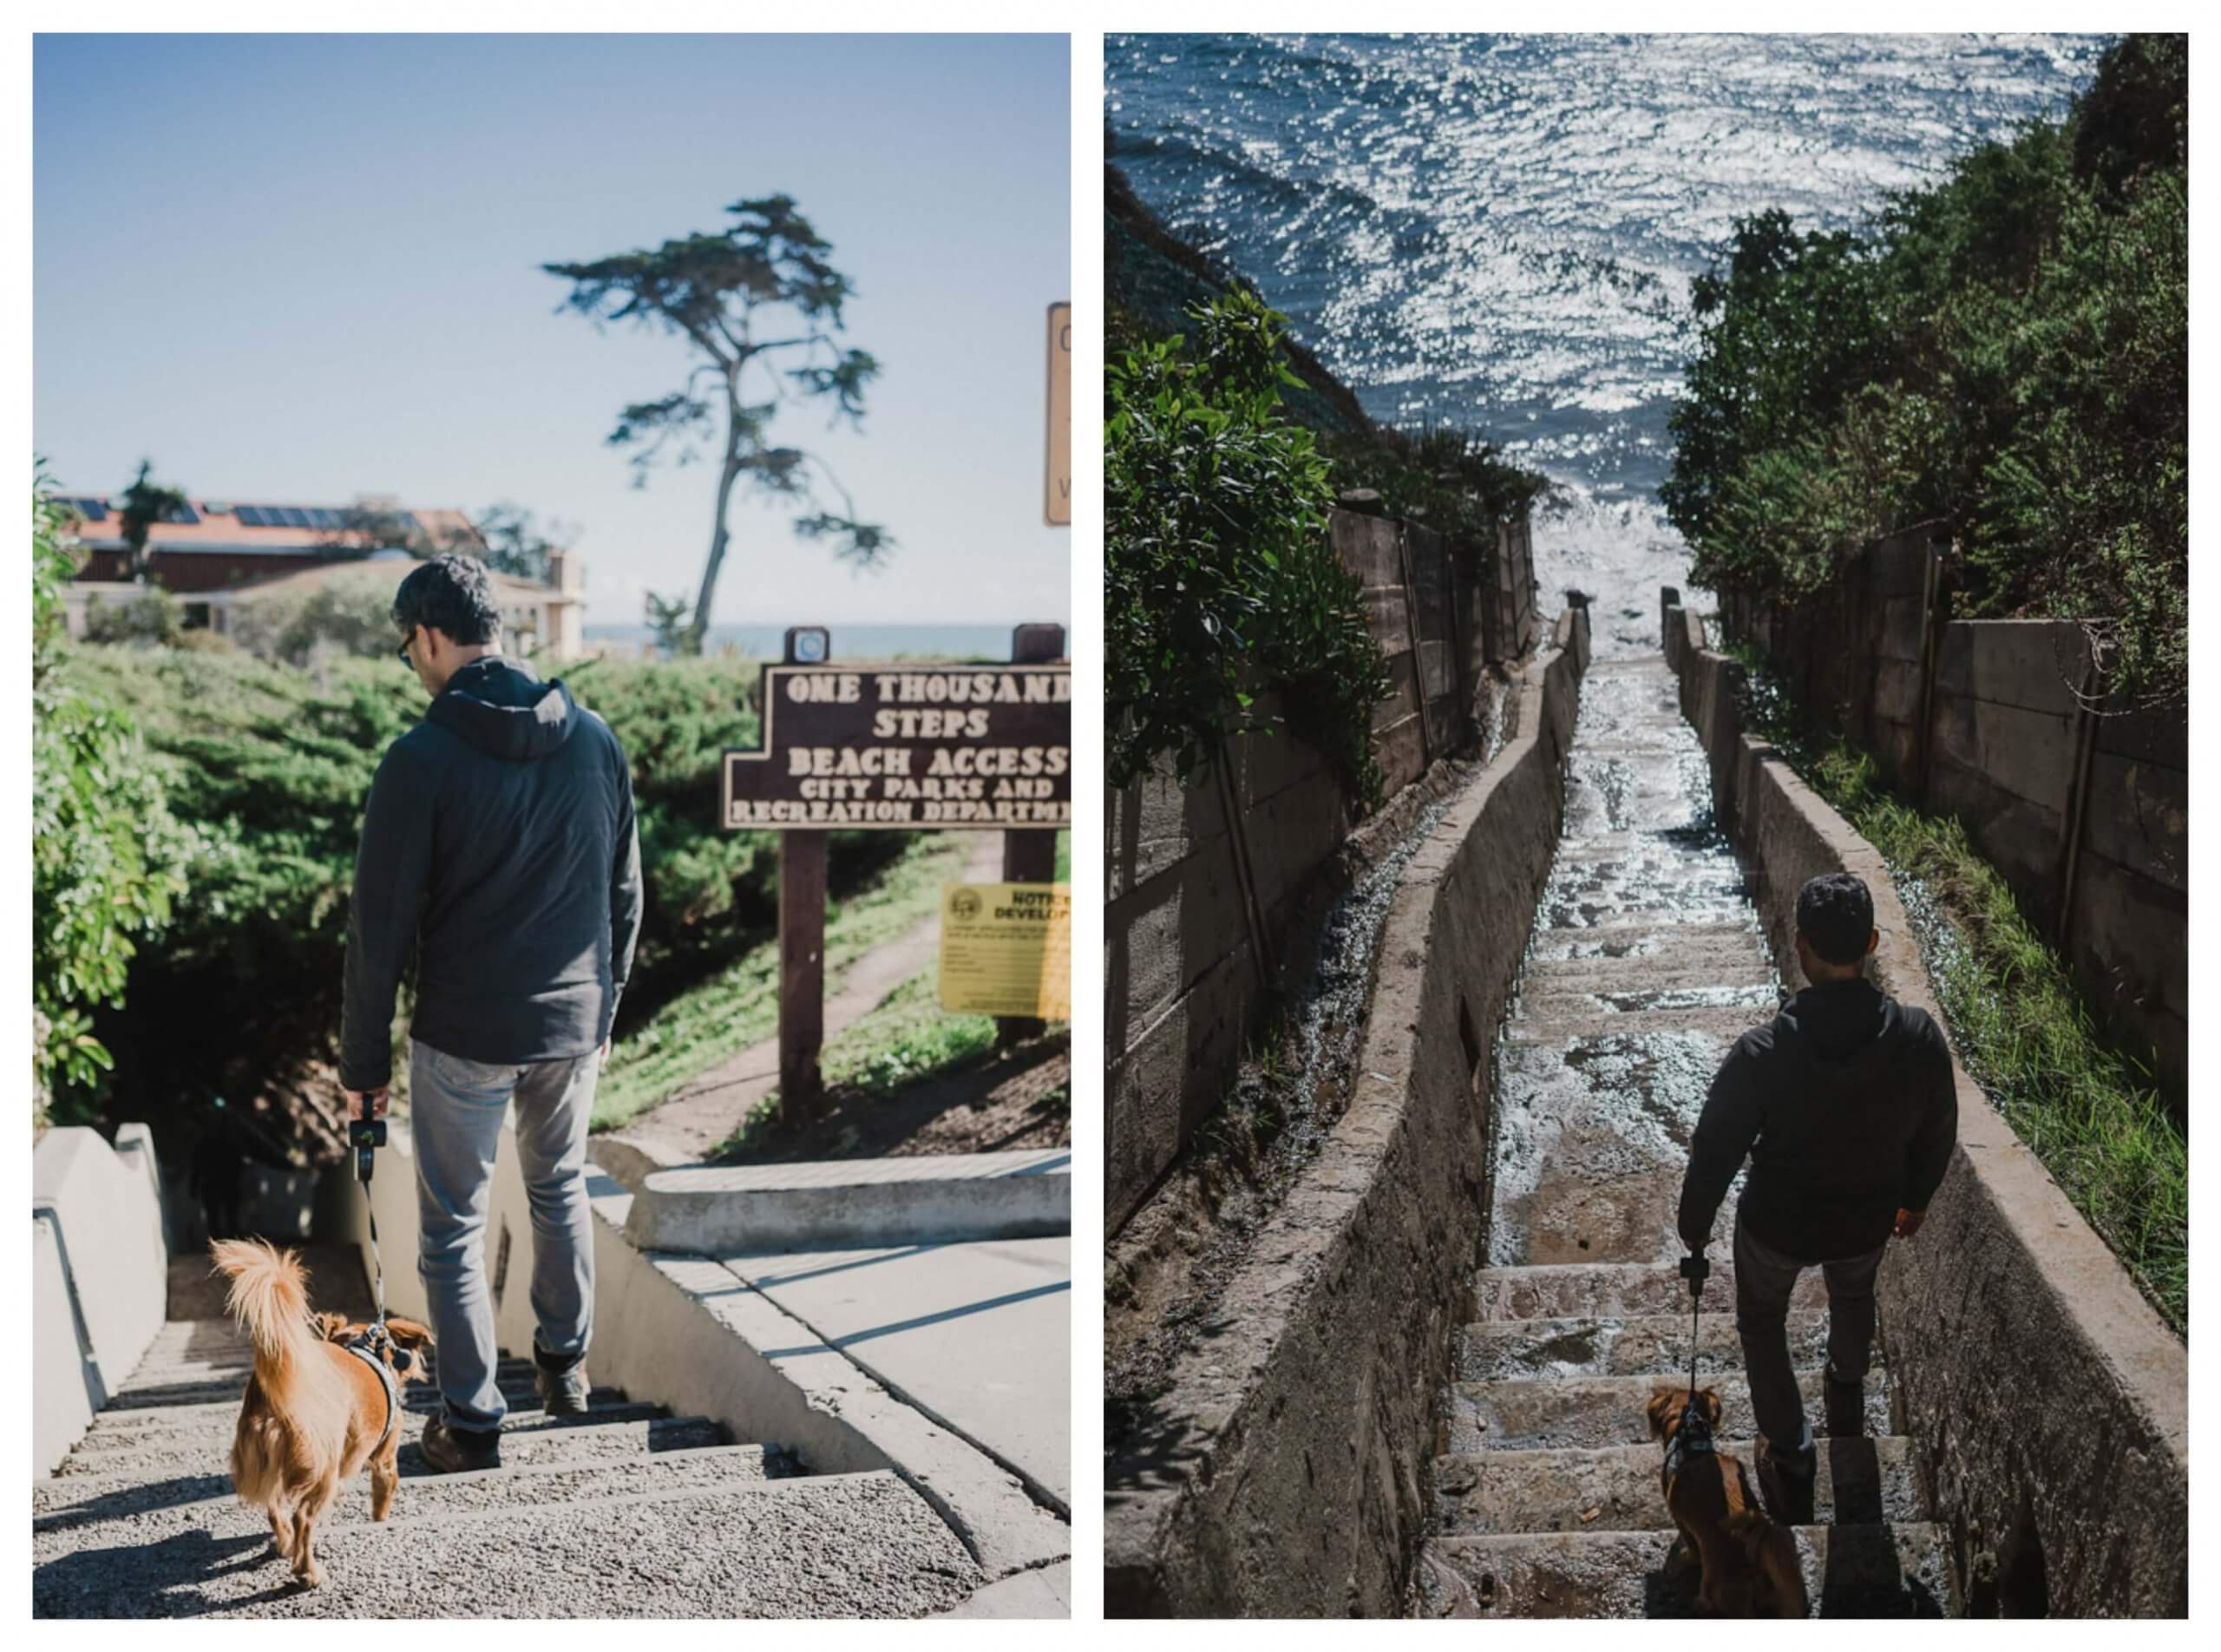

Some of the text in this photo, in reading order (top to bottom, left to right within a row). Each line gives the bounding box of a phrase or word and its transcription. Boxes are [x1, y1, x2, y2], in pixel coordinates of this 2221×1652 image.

[787, 674, 1071, 703] ONE THOUSAND
[873, 709, 989, 738] STEPS
[789, 747, 1068, 776] BEACH ACCESS
[799, 778, 1053, 800] CITY PARKS AND
[731, 800, 912, 823] RECREATION
